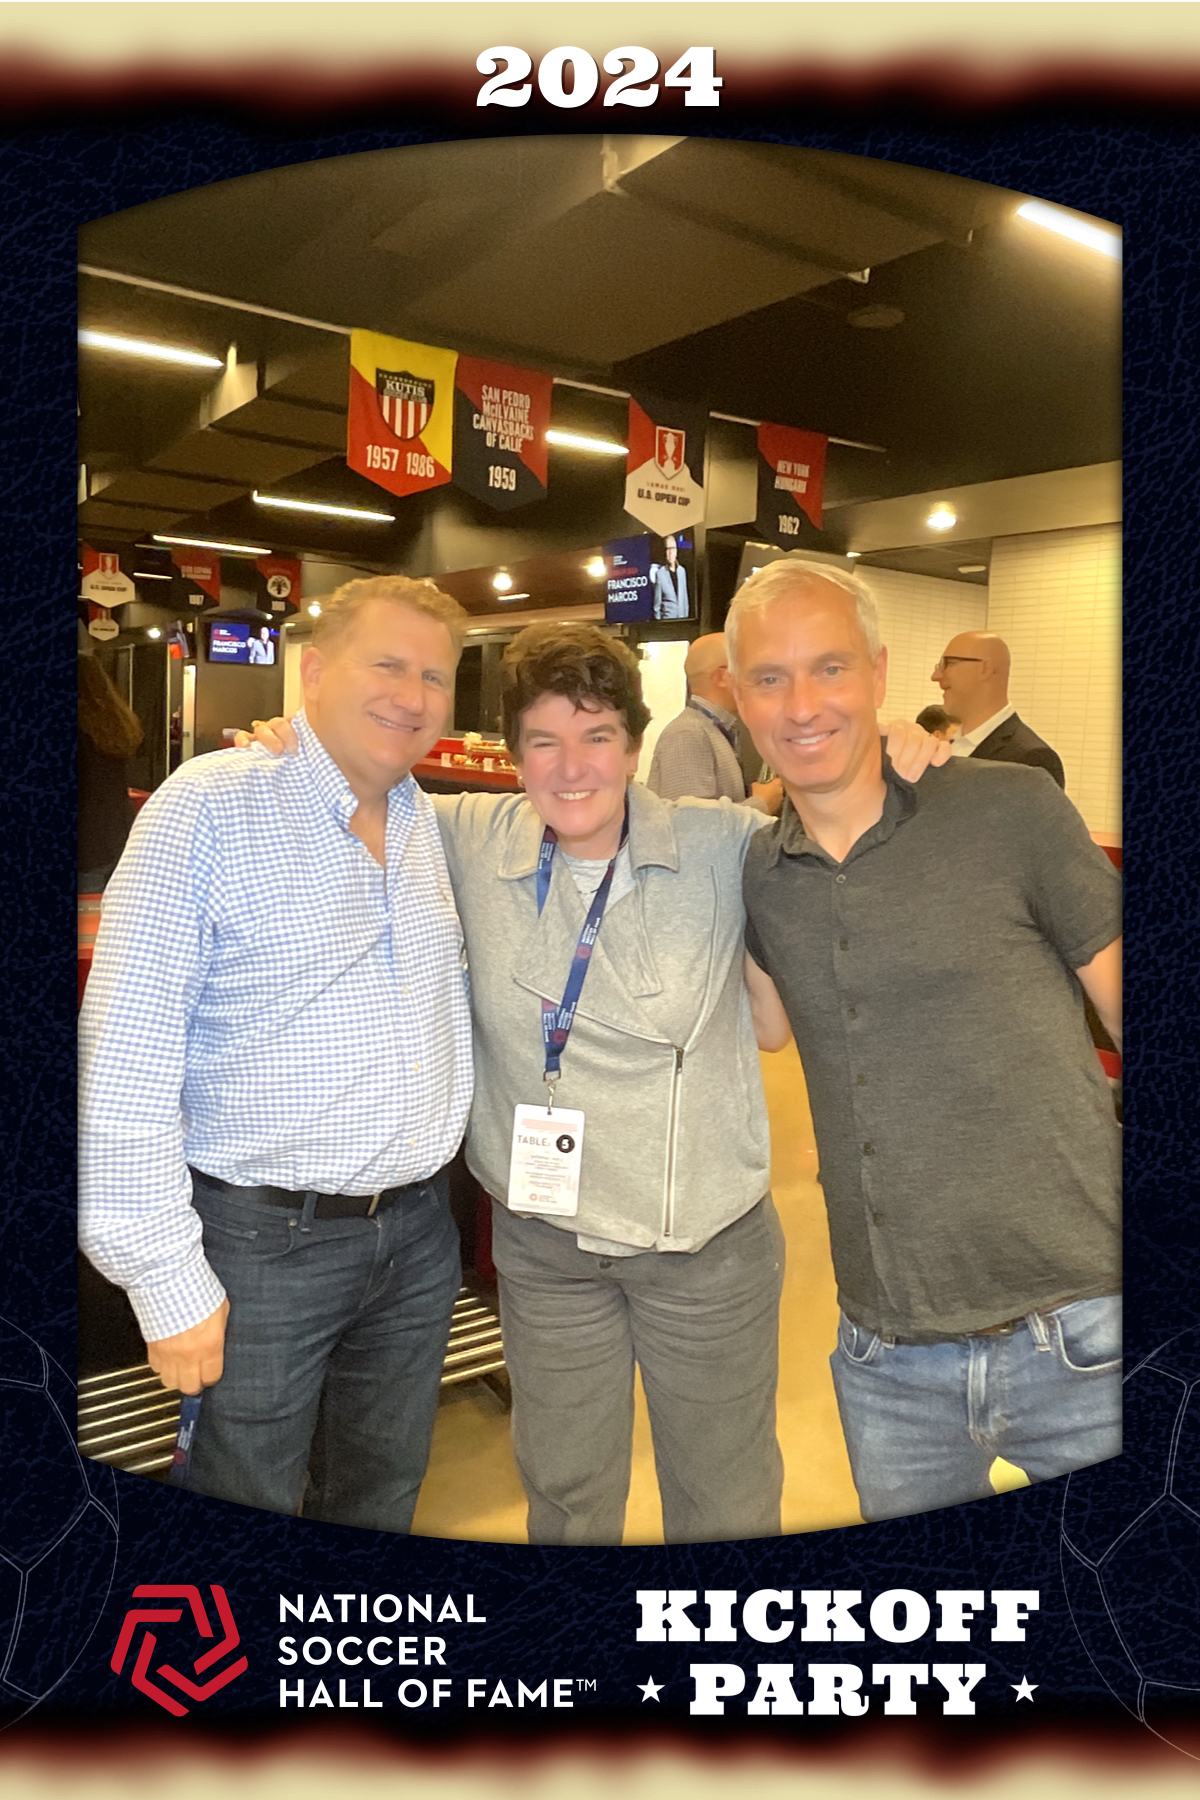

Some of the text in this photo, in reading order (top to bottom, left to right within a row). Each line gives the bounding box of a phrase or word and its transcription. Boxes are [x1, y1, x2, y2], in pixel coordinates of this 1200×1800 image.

[386, 379, 425, 397] KUTIS
[482, 384, 531, 409] SAN PEDRO
[482, 401, 530, 424] McILVAINE
[473, 414, 534, 440] CANVASBACKS
[486, 431, 498, 448] OF
[366, 444, 435, 478] 1957 1986
[488, 465, 516, 491] 1959
[637, 487, 691, 507] U.S. OPEN CUP
[778, 514, 800, 535] 1962
[607, 575, 648, 590] FRANCISCO
[608, 590, 639, 603] MARCOS
